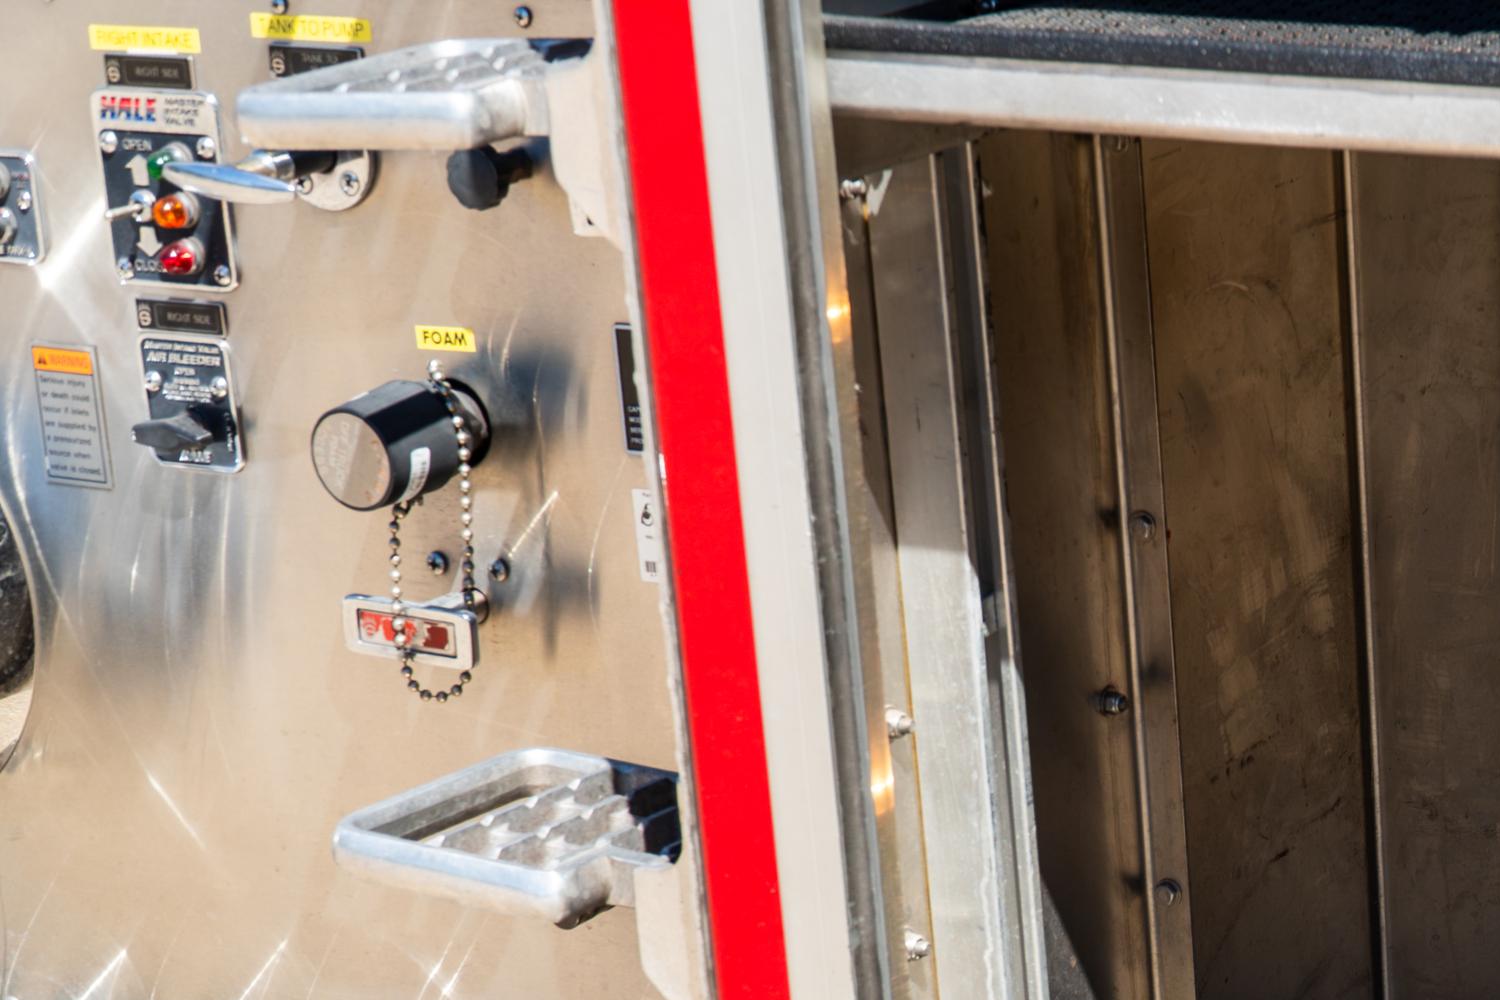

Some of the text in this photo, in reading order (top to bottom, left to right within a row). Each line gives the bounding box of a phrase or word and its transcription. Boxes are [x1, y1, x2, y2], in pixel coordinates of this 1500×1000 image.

[258, 18, 364, 38] TANK TO PUMP
[95, 30, 193, 48] RIGHT INTAKE
[100, 95, 157, 121] HALE
[122, 138, 152, 151] OPEN
[134, 259, 166, 272] CLOS
[422, 330, 468, 346] FOAM
[146, 351, 221, 367] AIR BLEEDER
